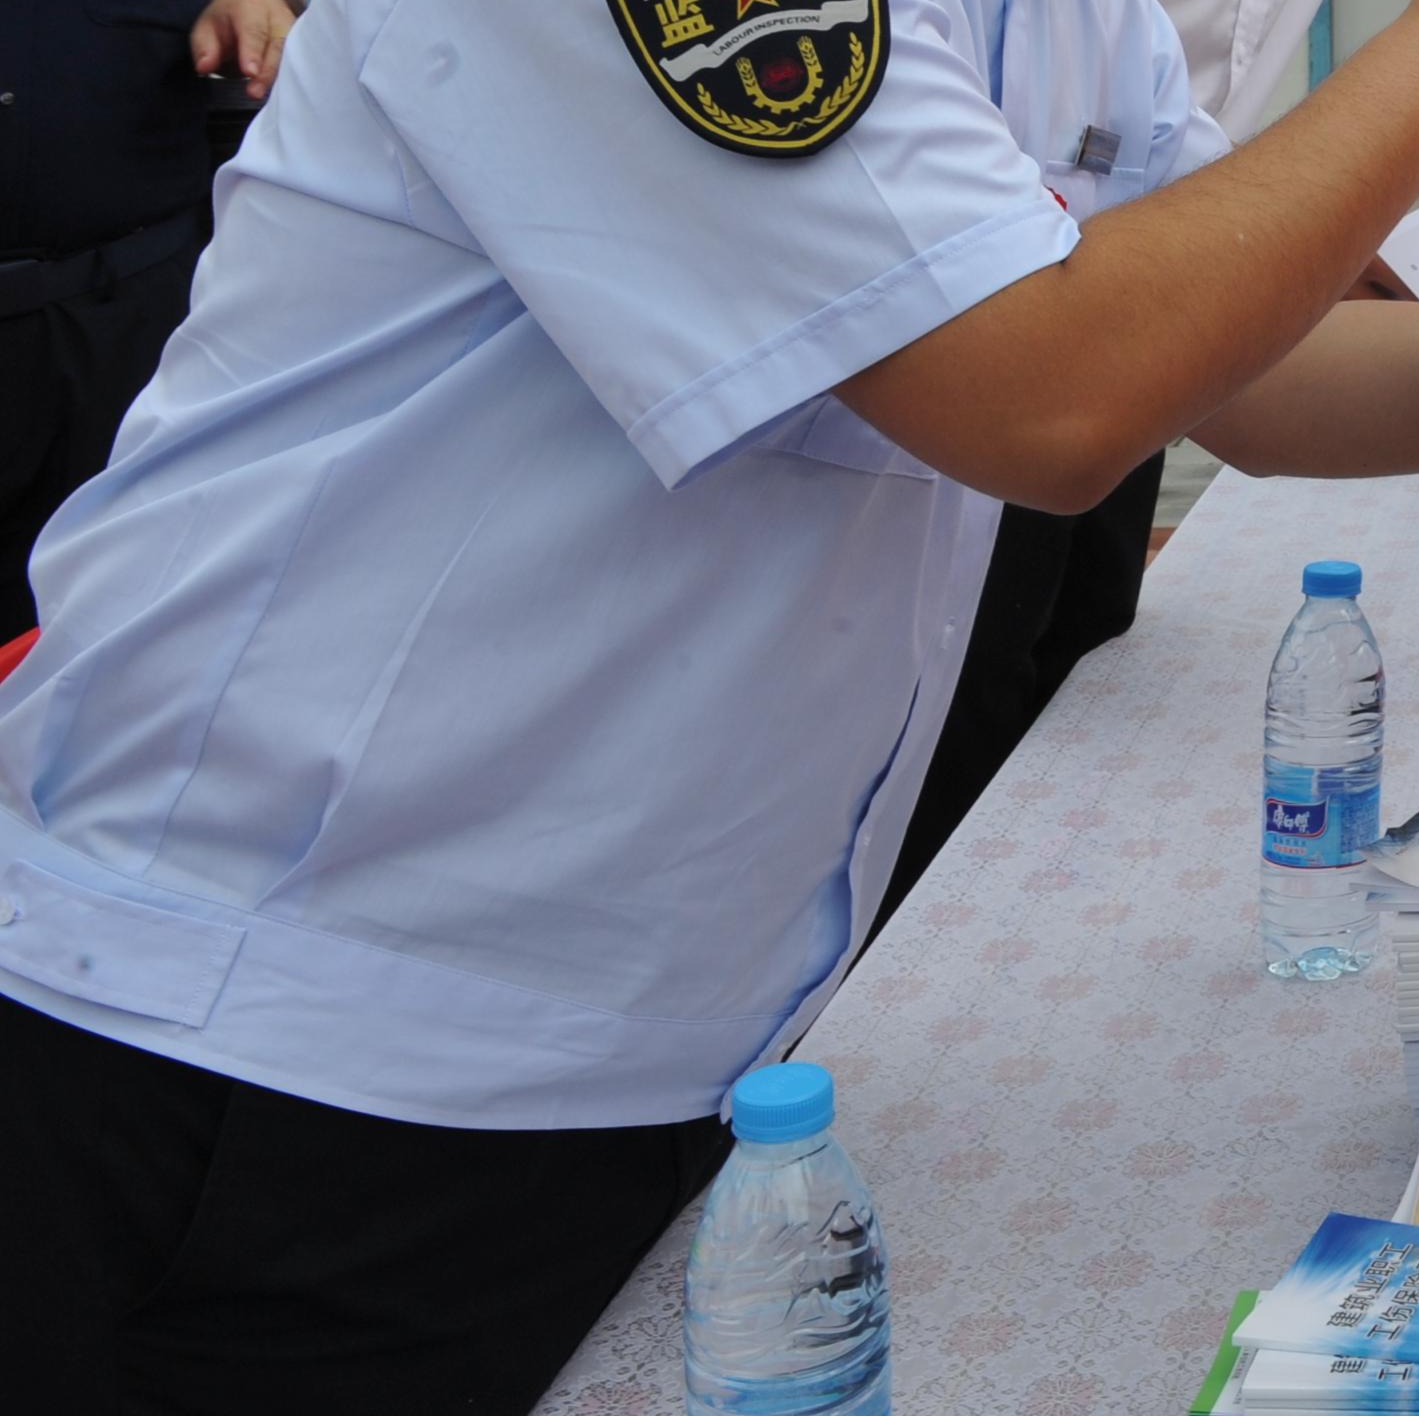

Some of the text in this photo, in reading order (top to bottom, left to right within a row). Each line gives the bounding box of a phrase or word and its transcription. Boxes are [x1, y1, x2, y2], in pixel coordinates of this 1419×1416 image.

[711, 14, 821, 57] LABOUR INSPECTION
[1326, 1241, 1413, 1328] 建筑业职工
